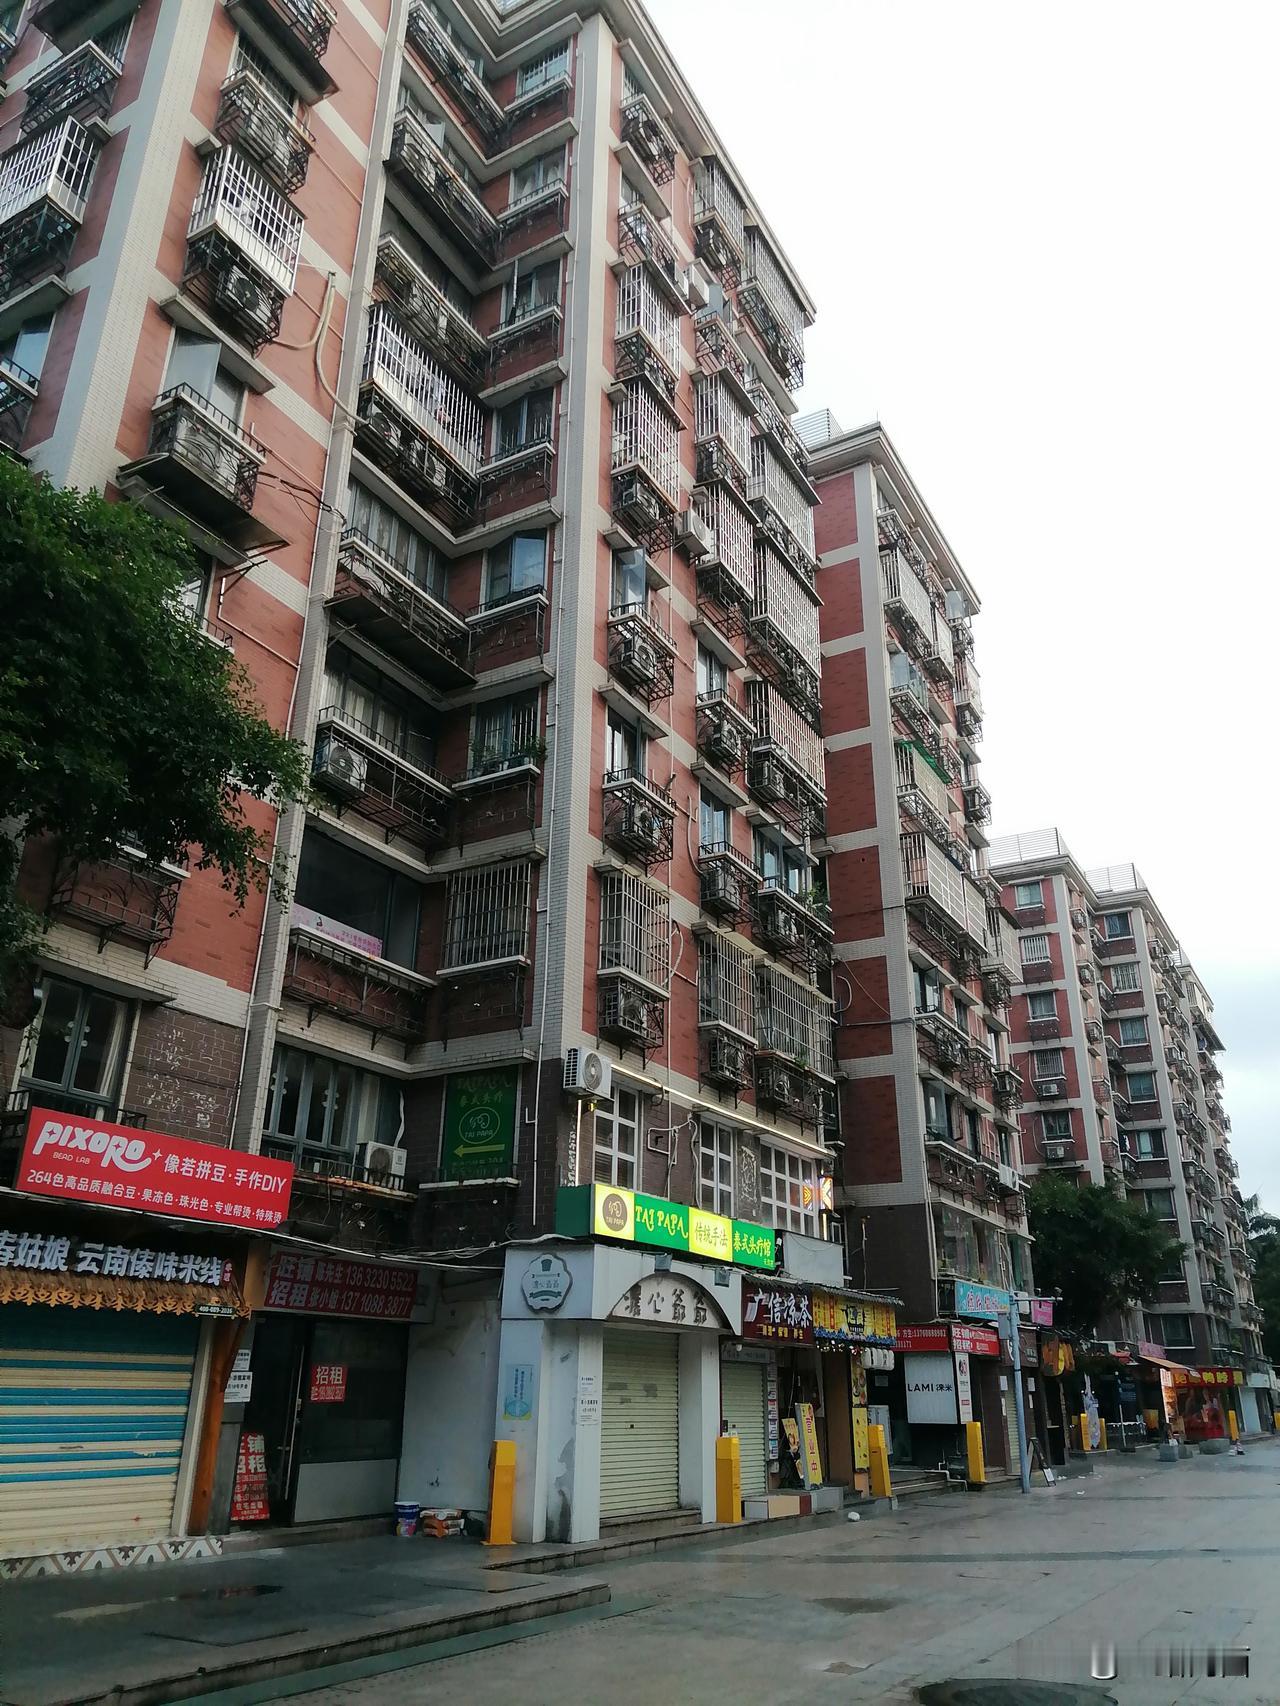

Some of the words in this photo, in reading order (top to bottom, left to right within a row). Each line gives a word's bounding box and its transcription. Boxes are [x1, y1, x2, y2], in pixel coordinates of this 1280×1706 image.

[52, 1152, 73, 1162] BEAD
[75, 1156, 90, 1165] LAB
[635, 1206, 655, 1233] TAI
[657, 1210, 689, 1239] PAPA
[694, 1220, 728, 1249] 传统手法
[733, 1231, 772, 1258] 泰式头疗馆
[77, 1242, 223, 1287] 云南傣味米线
[346, 1266, 363, 1287] 136
[269, 1280, 308, 1306] 招租
[341, 1290, 360, 1311] 137
[316, 1366, 343, 1385] 招租
[907, 1383, 934, 1392] LAMI
